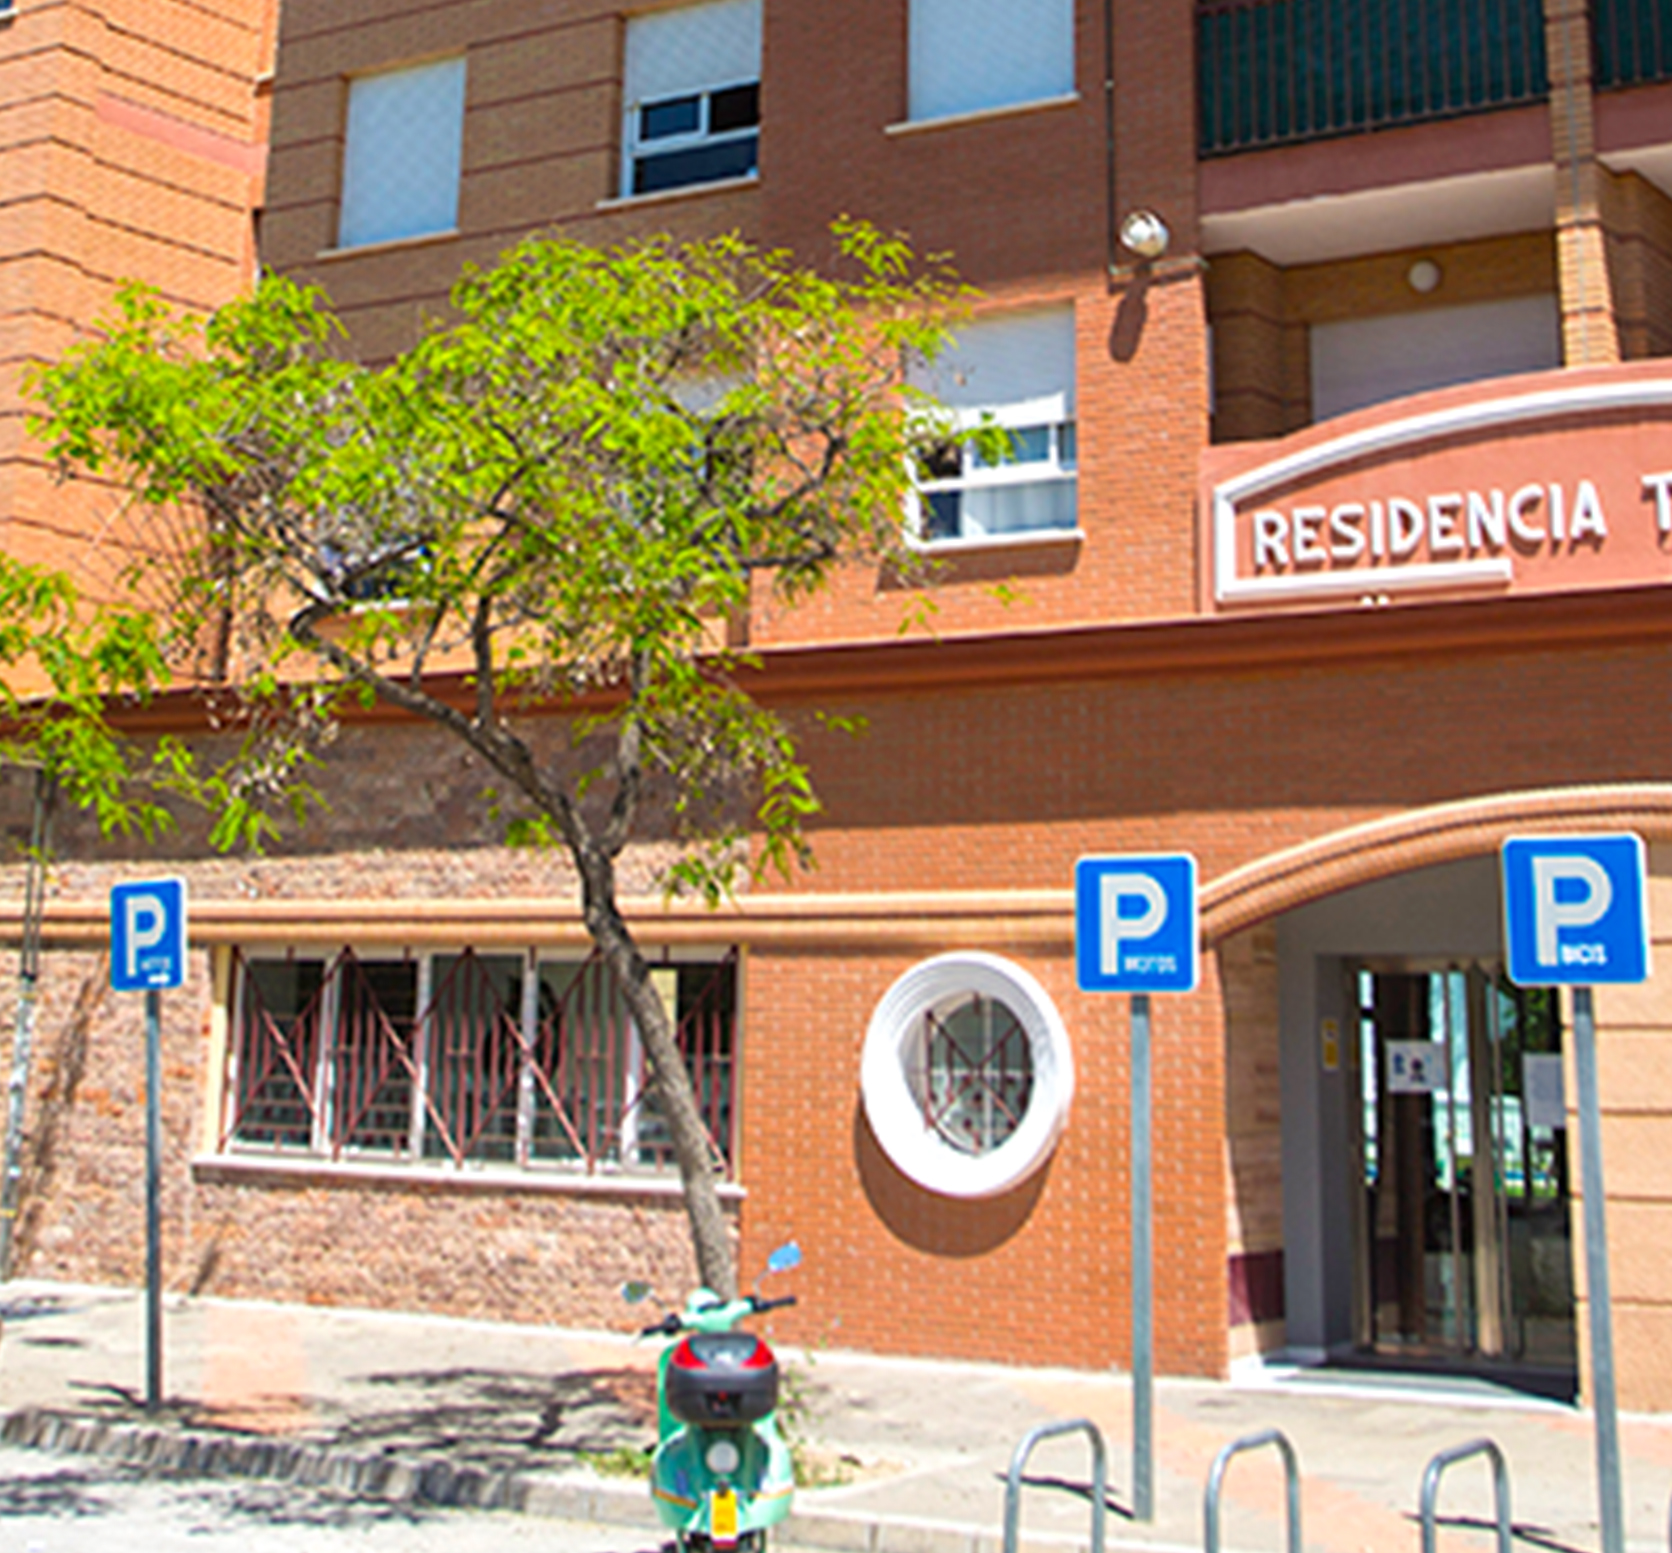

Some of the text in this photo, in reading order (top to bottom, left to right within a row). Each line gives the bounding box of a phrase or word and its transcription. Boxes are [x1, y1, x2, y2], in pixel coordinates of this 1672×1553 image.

[1253, 479, 1608, 565] RESIDENCIA
[126, 895, 165, 976] P
[1100, 873, 1168, 975] P
[1532, 855, 1612, 966] P
